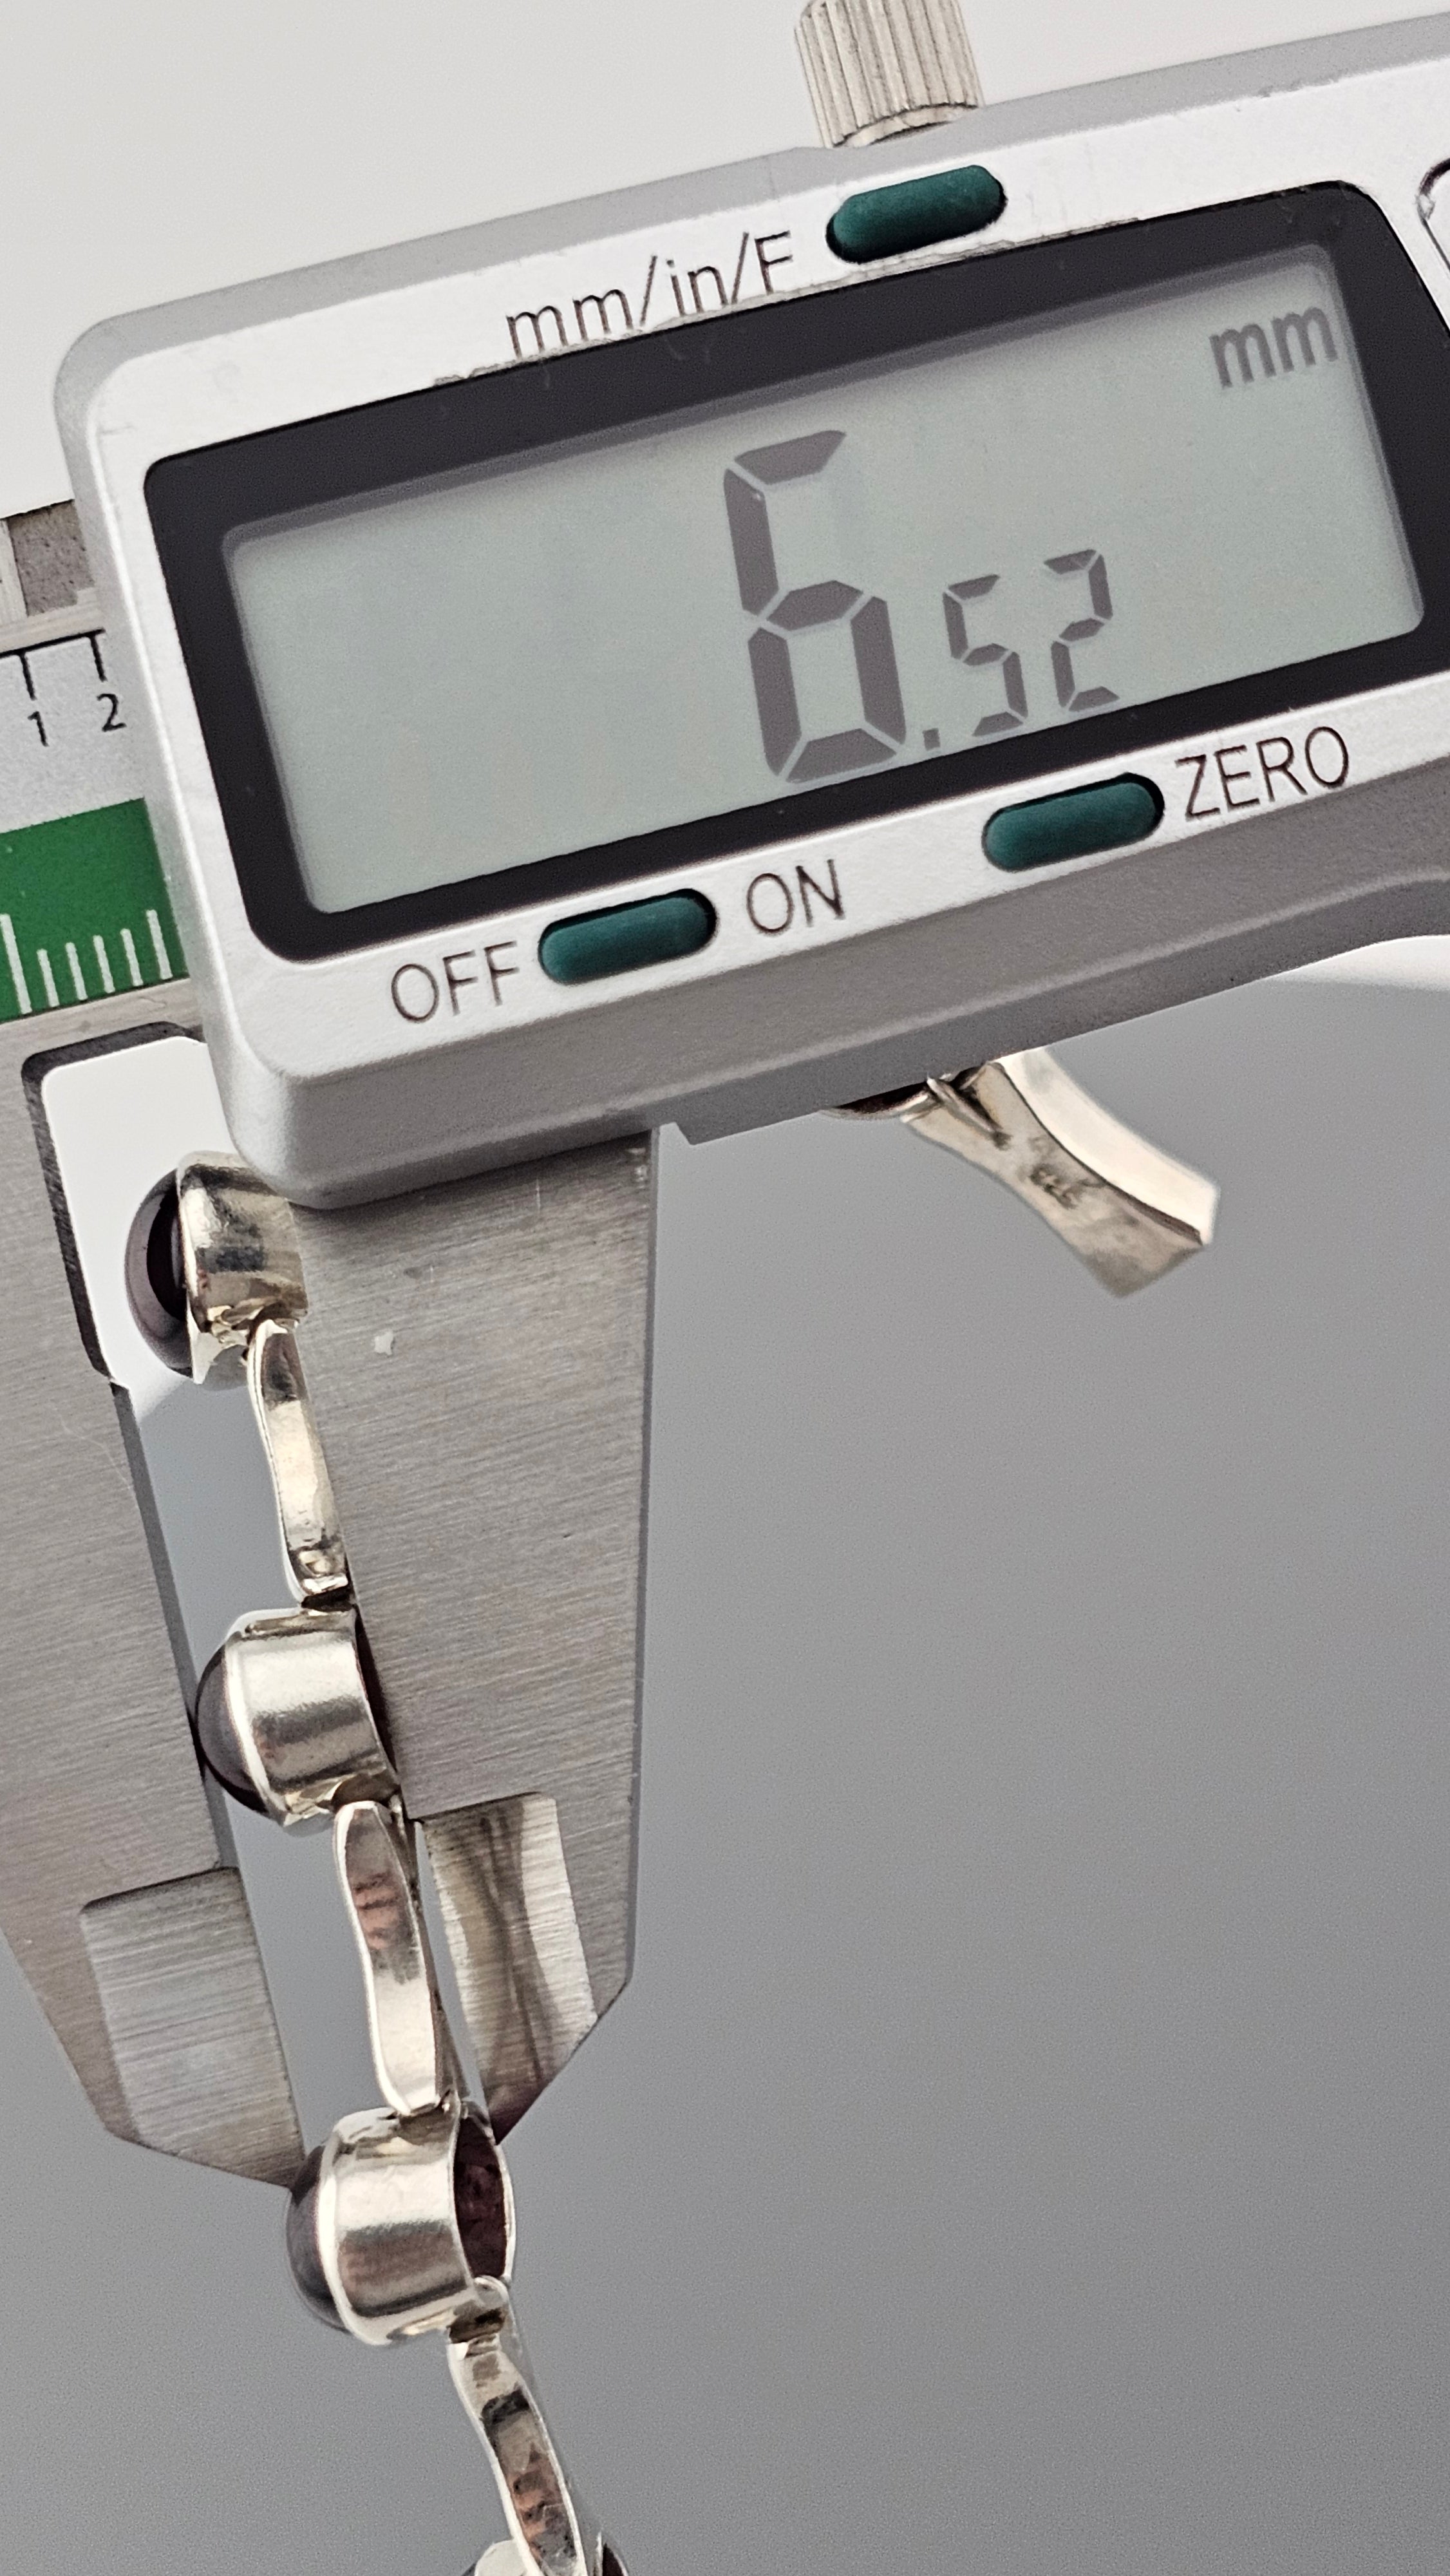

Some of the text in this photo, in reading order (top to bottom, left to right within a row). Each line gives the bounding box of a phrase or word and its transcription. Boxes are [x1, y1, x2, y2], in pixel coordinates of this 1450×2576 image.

[506, 230, 793, 359] mm/in/F
[1209, 307, 1339, 389] mm
[723, 429, 1120, 784] 6.52
[27, 692, 127, 747] 1 2
[1174, 726, 1350, 822] ZERO
[746, 858, 847, 935] ON
[391, 940, 520, 1023] OFF
